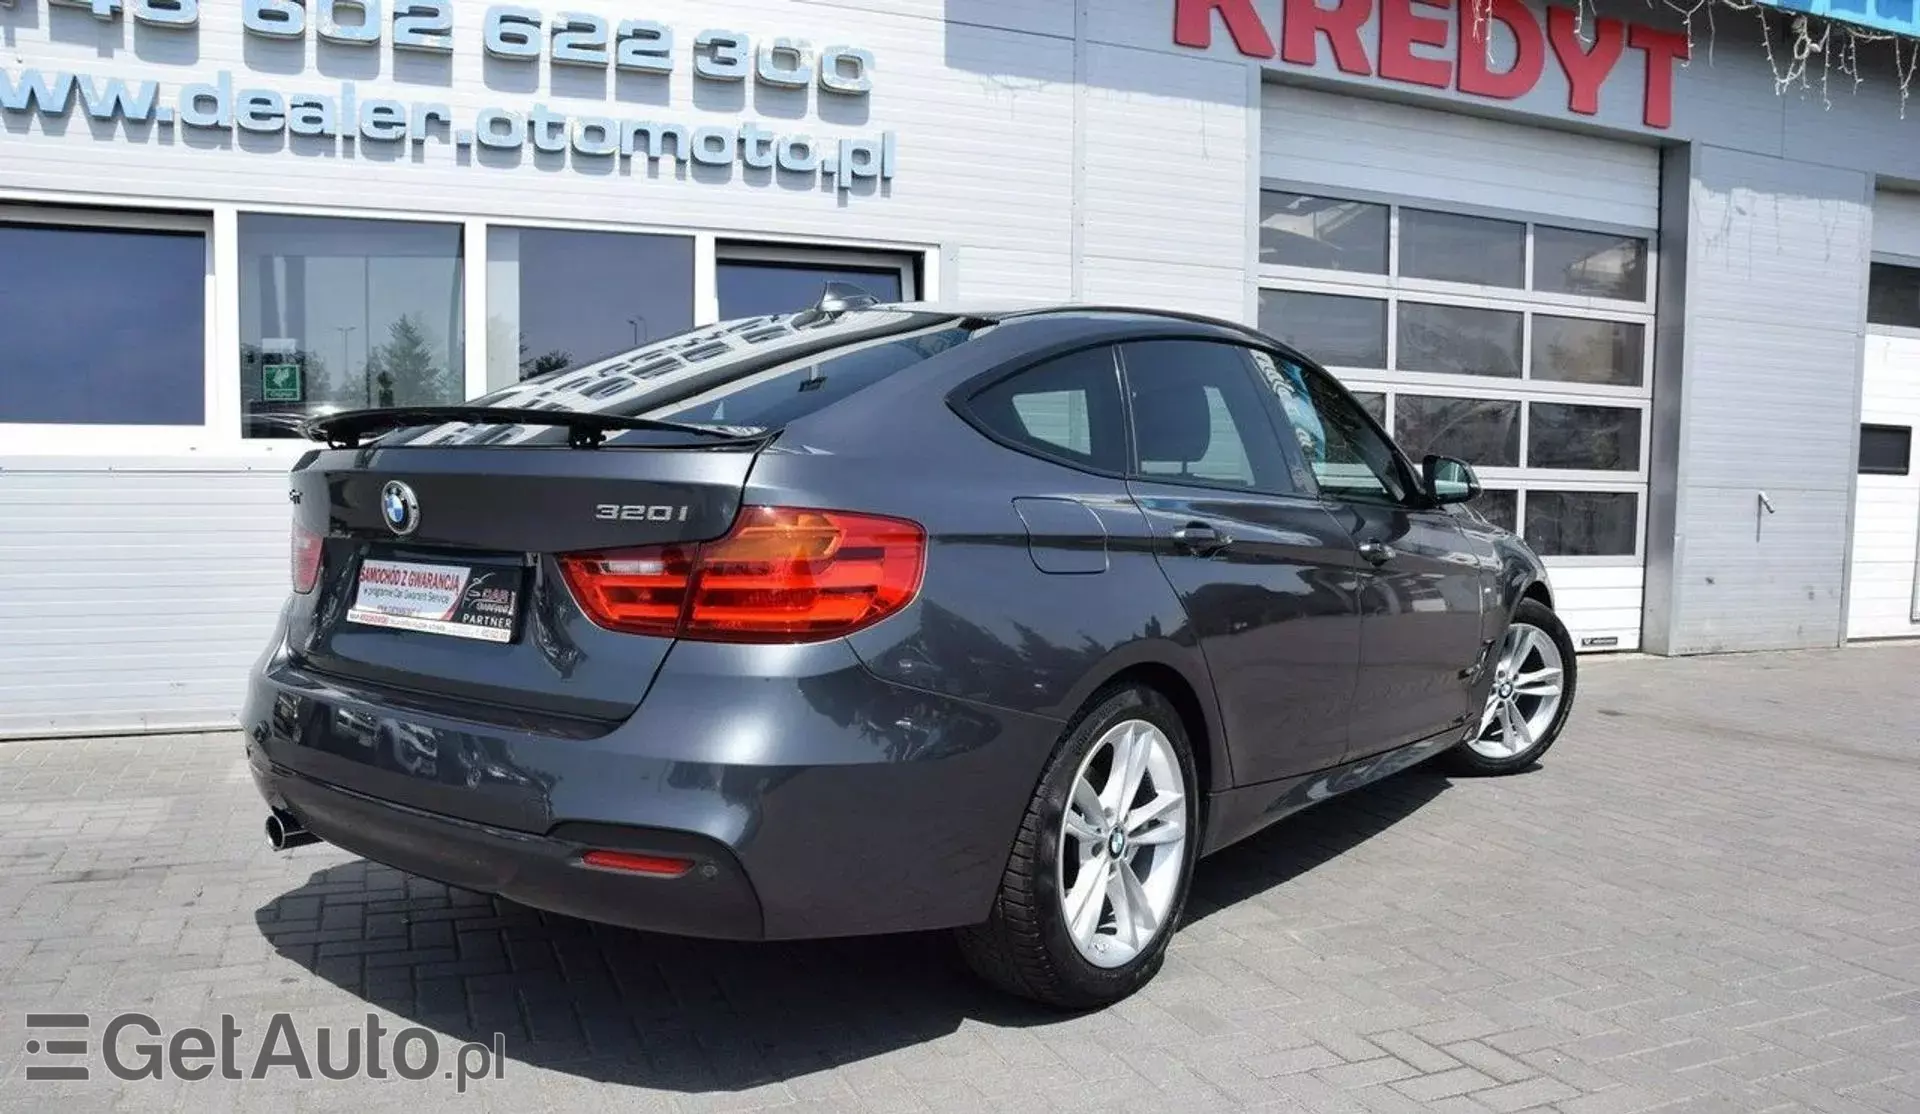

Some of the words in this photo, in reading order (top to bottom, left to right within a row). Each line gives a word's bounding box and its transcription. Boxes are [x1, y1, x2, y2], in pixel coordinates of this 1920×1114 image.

[243, 0, 454, 49] 602
[483, 5, 675, 74] 622
[692, 28, 877, 94] 300
[408, 571, 460, 592] GWARANCJA
[463, 613, 513, 629] PARTNER
